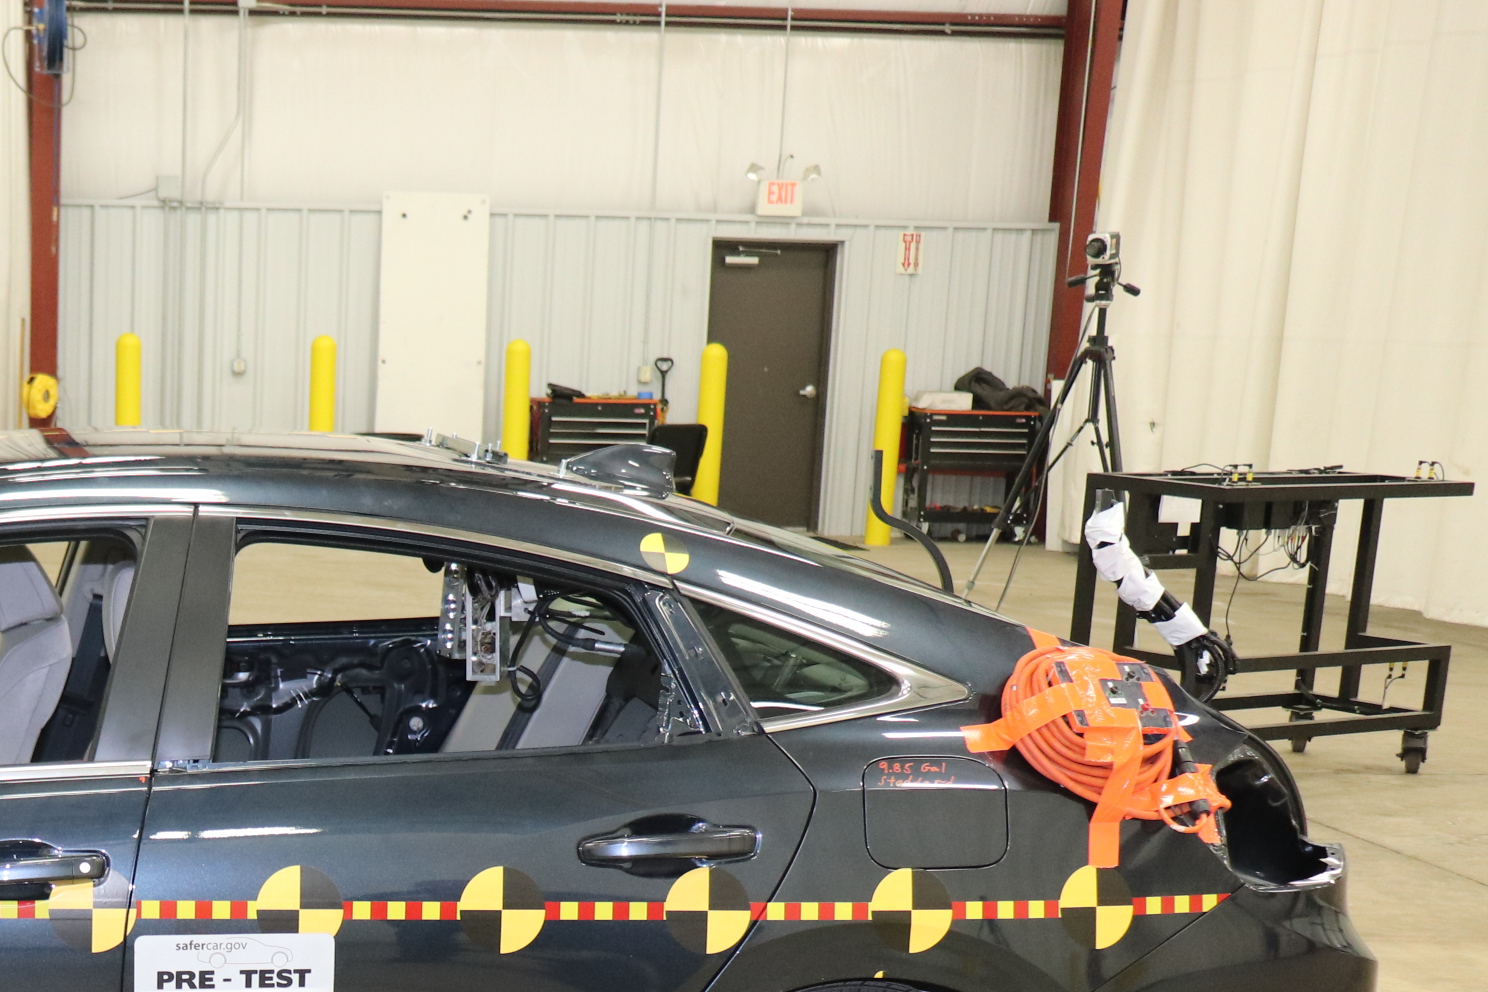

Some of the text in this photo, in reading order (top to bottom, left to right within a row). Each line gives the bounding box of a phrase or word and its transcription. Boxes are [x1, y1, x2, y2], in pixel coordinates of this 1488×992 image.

[767, 181, 797, 204] EXIT
[878, 761, 946, 774] 9.85 Gal
[175, 940, 248, 953] safercar.gov
[156, 970, 216, 990] PRE
[239, 968, 312, 988] TEST
